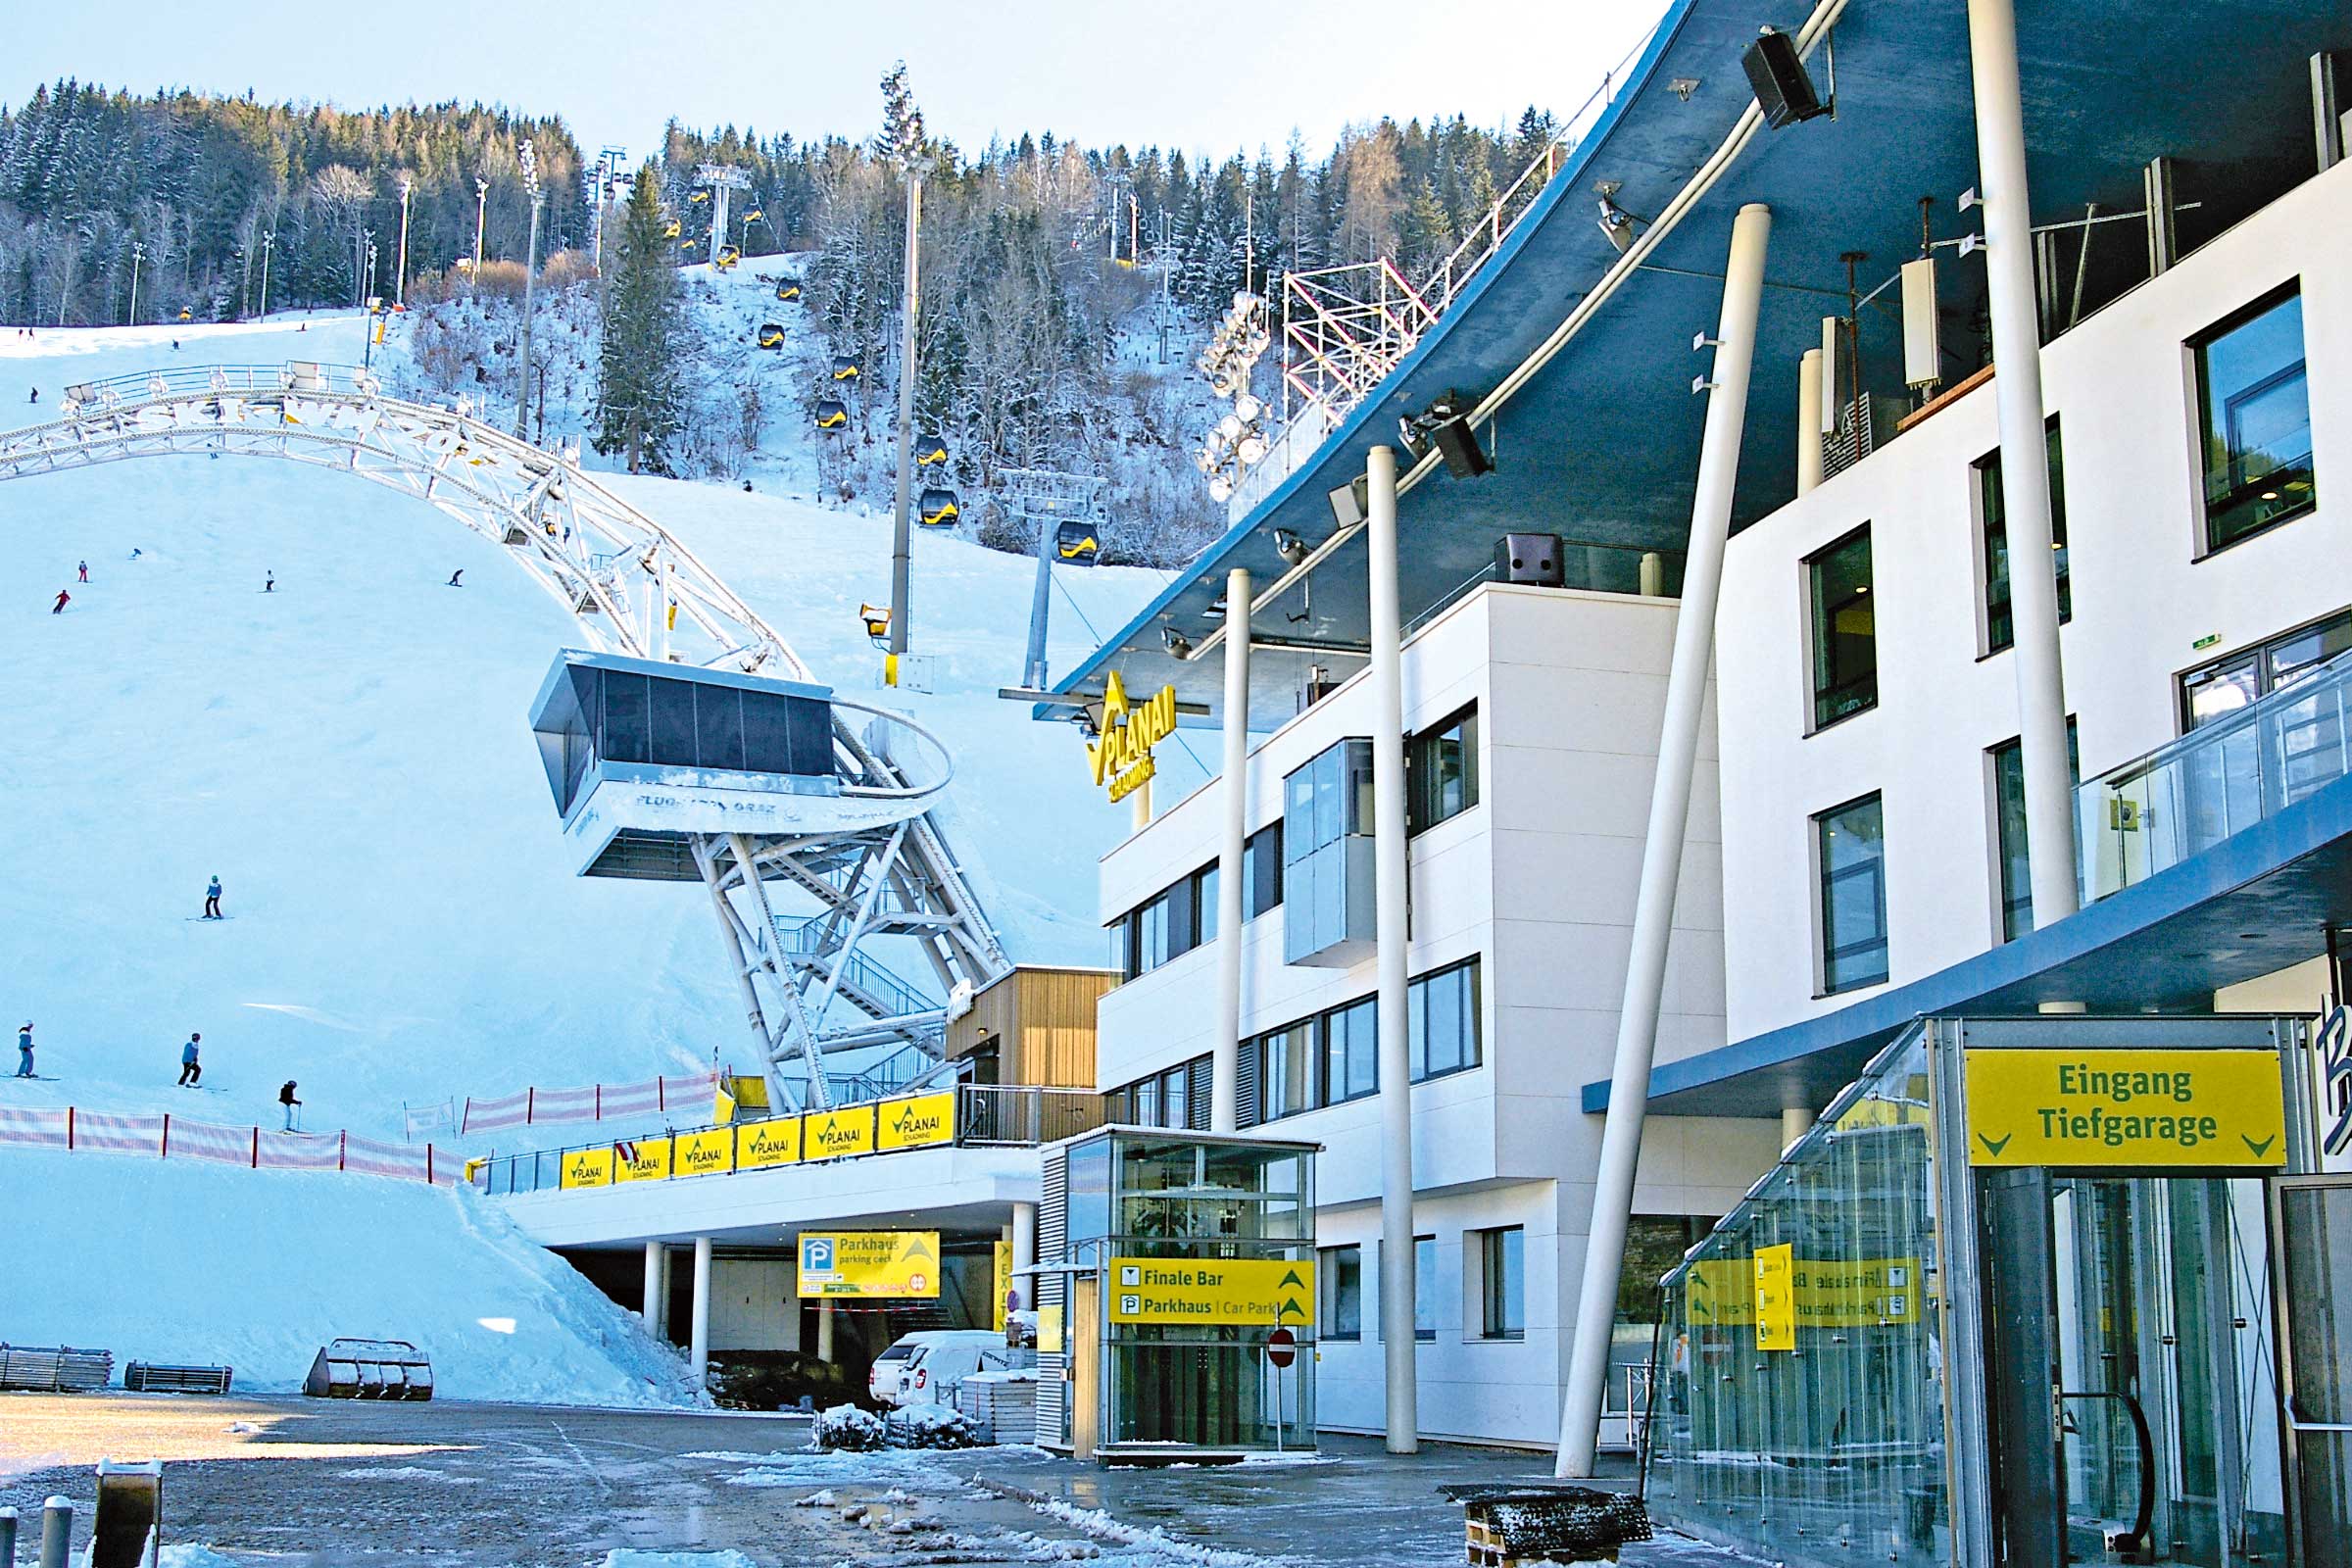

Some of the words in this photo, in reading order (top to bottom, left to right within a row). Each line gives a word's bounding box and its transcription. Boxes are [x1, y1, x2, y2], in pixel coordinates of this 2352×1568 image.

[1104, 684, 1176, 779] PLANAI
[2059, 1064, 2191, 1102] Eingang
[903, 1116, 940, 1134] PLANAI
[2037, 1107, 2217, 1147] Tiefgarage
[826, 1129, 860, 1146] PLANAI
[757, 1140, 788, 1154] PLANAI
[693, 1149, 721, 1163] PLANAI
[577, 1166, 602, 1179] PLANAI
[632, 1158, 660, 1172] PLANAI
[840, 1238, 899, 1250] Parkhaus
[840, 1254, 871, 1265] parking
[1145, 1270, 1193, 1286] Finale
[1198, 1271, 1223, 1286] Bar
[1145, 1298, 1211, 1313] Parkhaus
[1223, 1300, 1244, 1314] Car
[1248, 1300, 1277, 1314] Park
